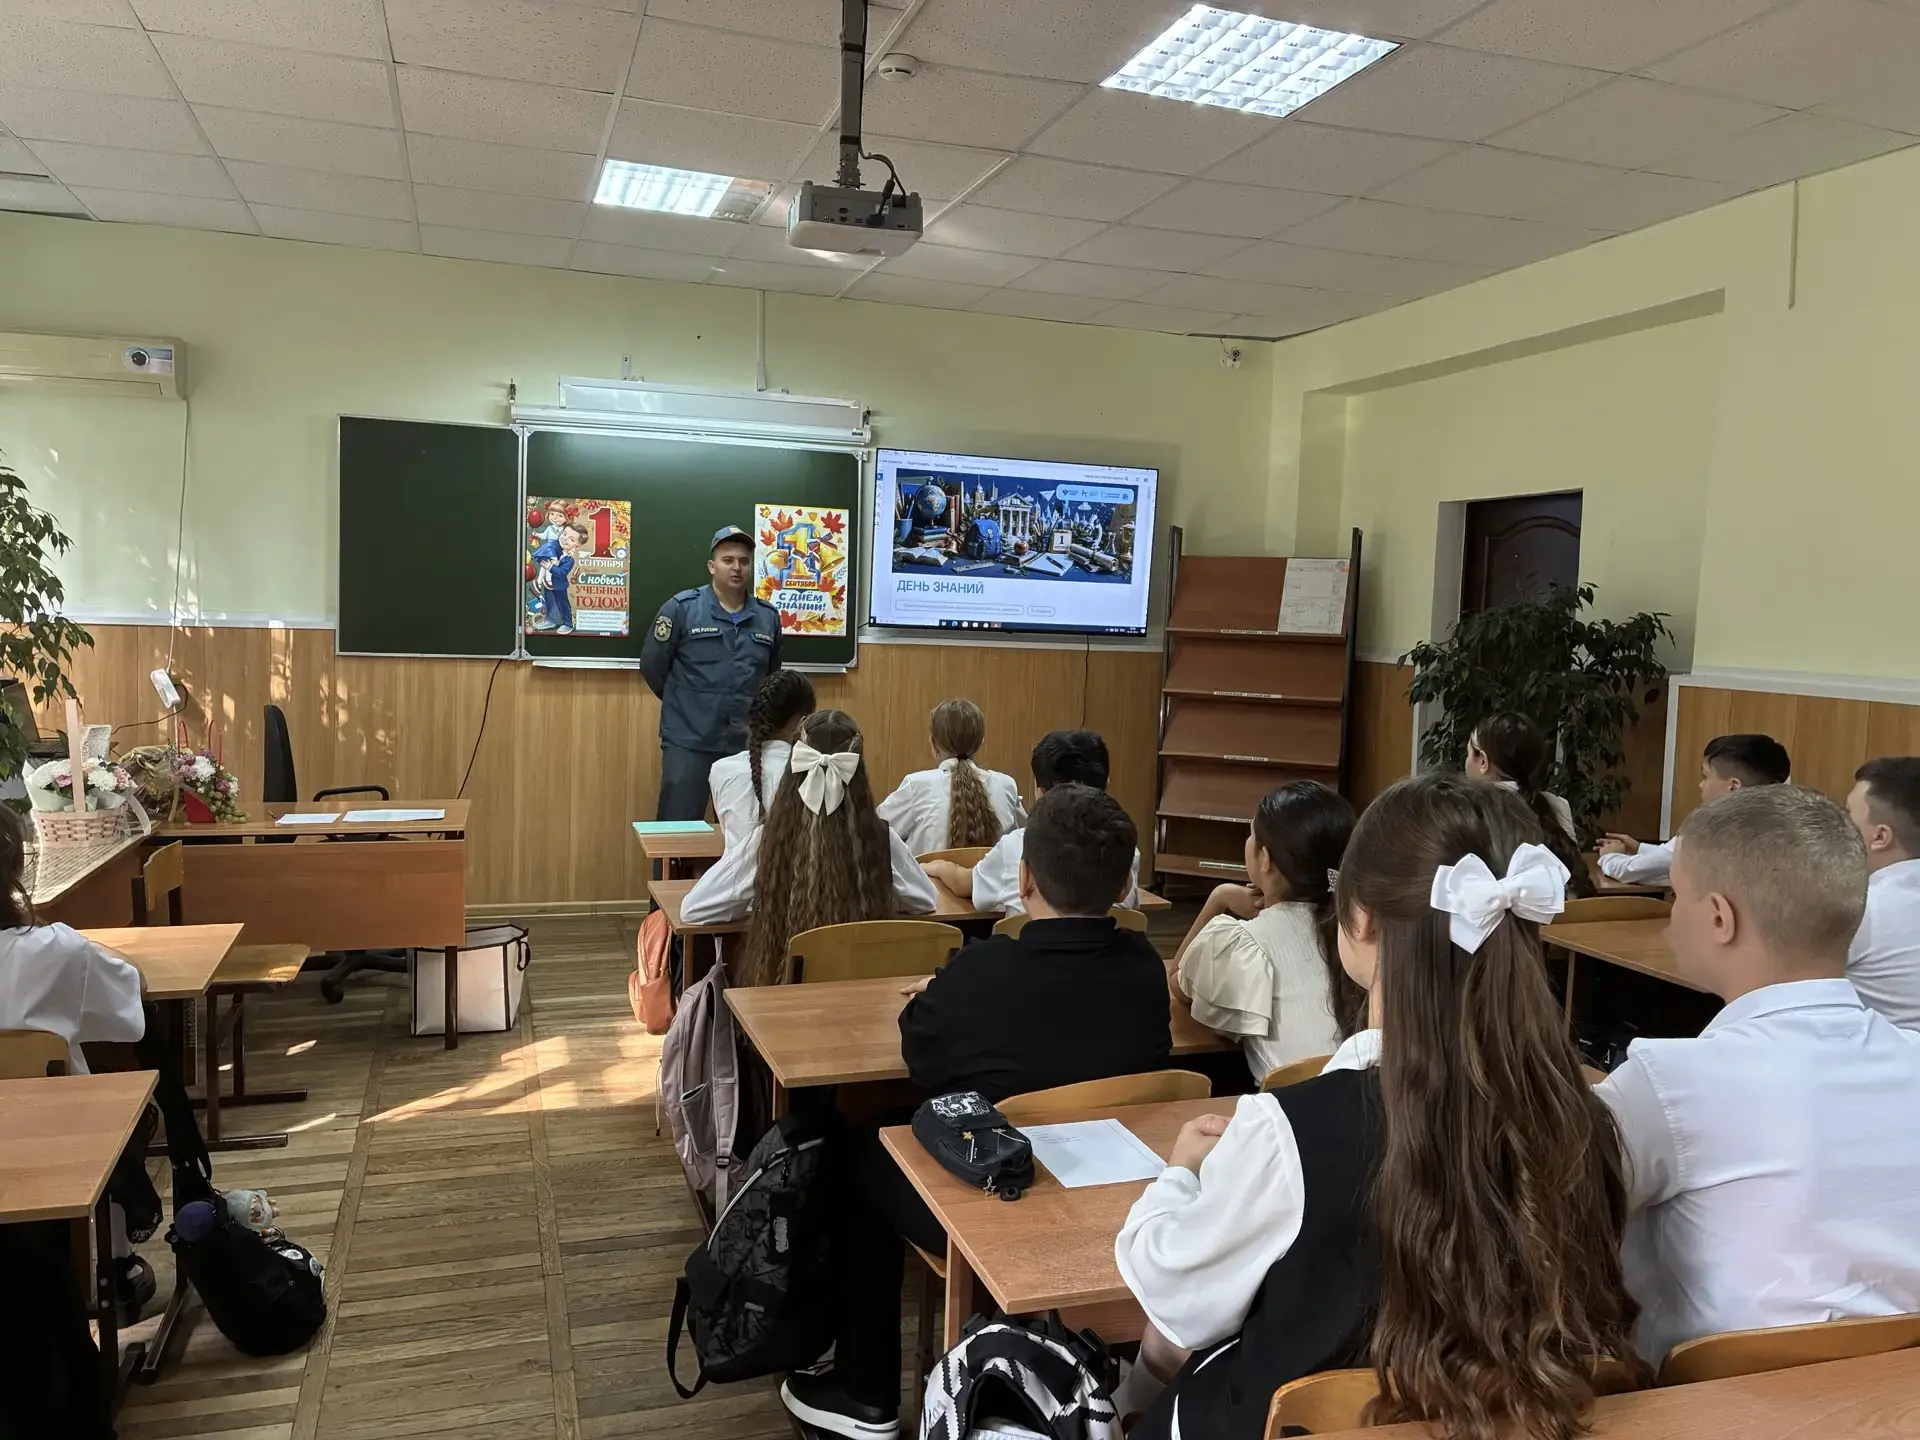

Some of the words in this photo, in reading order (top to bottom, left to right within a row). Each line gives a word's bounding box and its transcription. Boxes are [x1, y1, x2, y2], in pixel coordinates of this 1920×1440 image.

[588, 507, 615, 558] 1
[578, 559, 624, 568] СЕНТЯБРЯ
[575, 585, 627, 595] УЧЕБНЫМ
[785, 580, 816, 588] СЕНТЯБРЯ
[897, 579, 930, 592] ДЕНЬ
[932, 581, 985, 594] ЗНАНИЙ
[576, 595, 628, 609] ГОДОМ!
[779, 592, 786, 601] С
[789, 591, 823, 603] ДНЁМ
